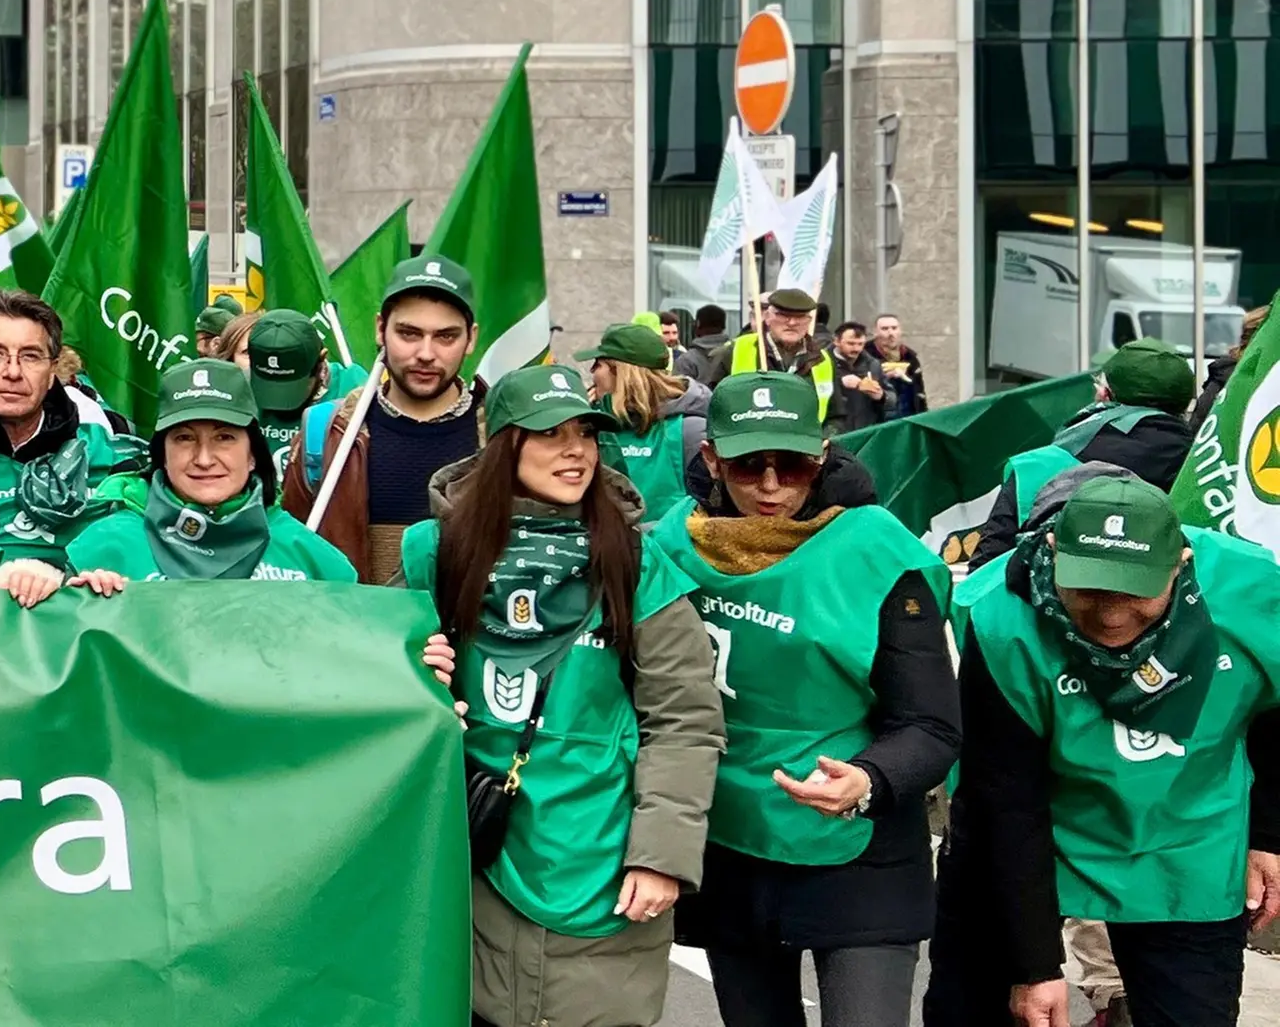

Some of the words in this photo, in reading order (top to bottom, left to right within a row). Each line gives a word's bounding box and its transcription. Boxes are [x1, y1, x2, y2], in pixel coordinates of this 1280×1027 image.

[731, 410, 799, 422] Confagricoltura
[1078, 533, 1151, 552] Confagricoltura
[701, 595, 795, 635] gricoltura
